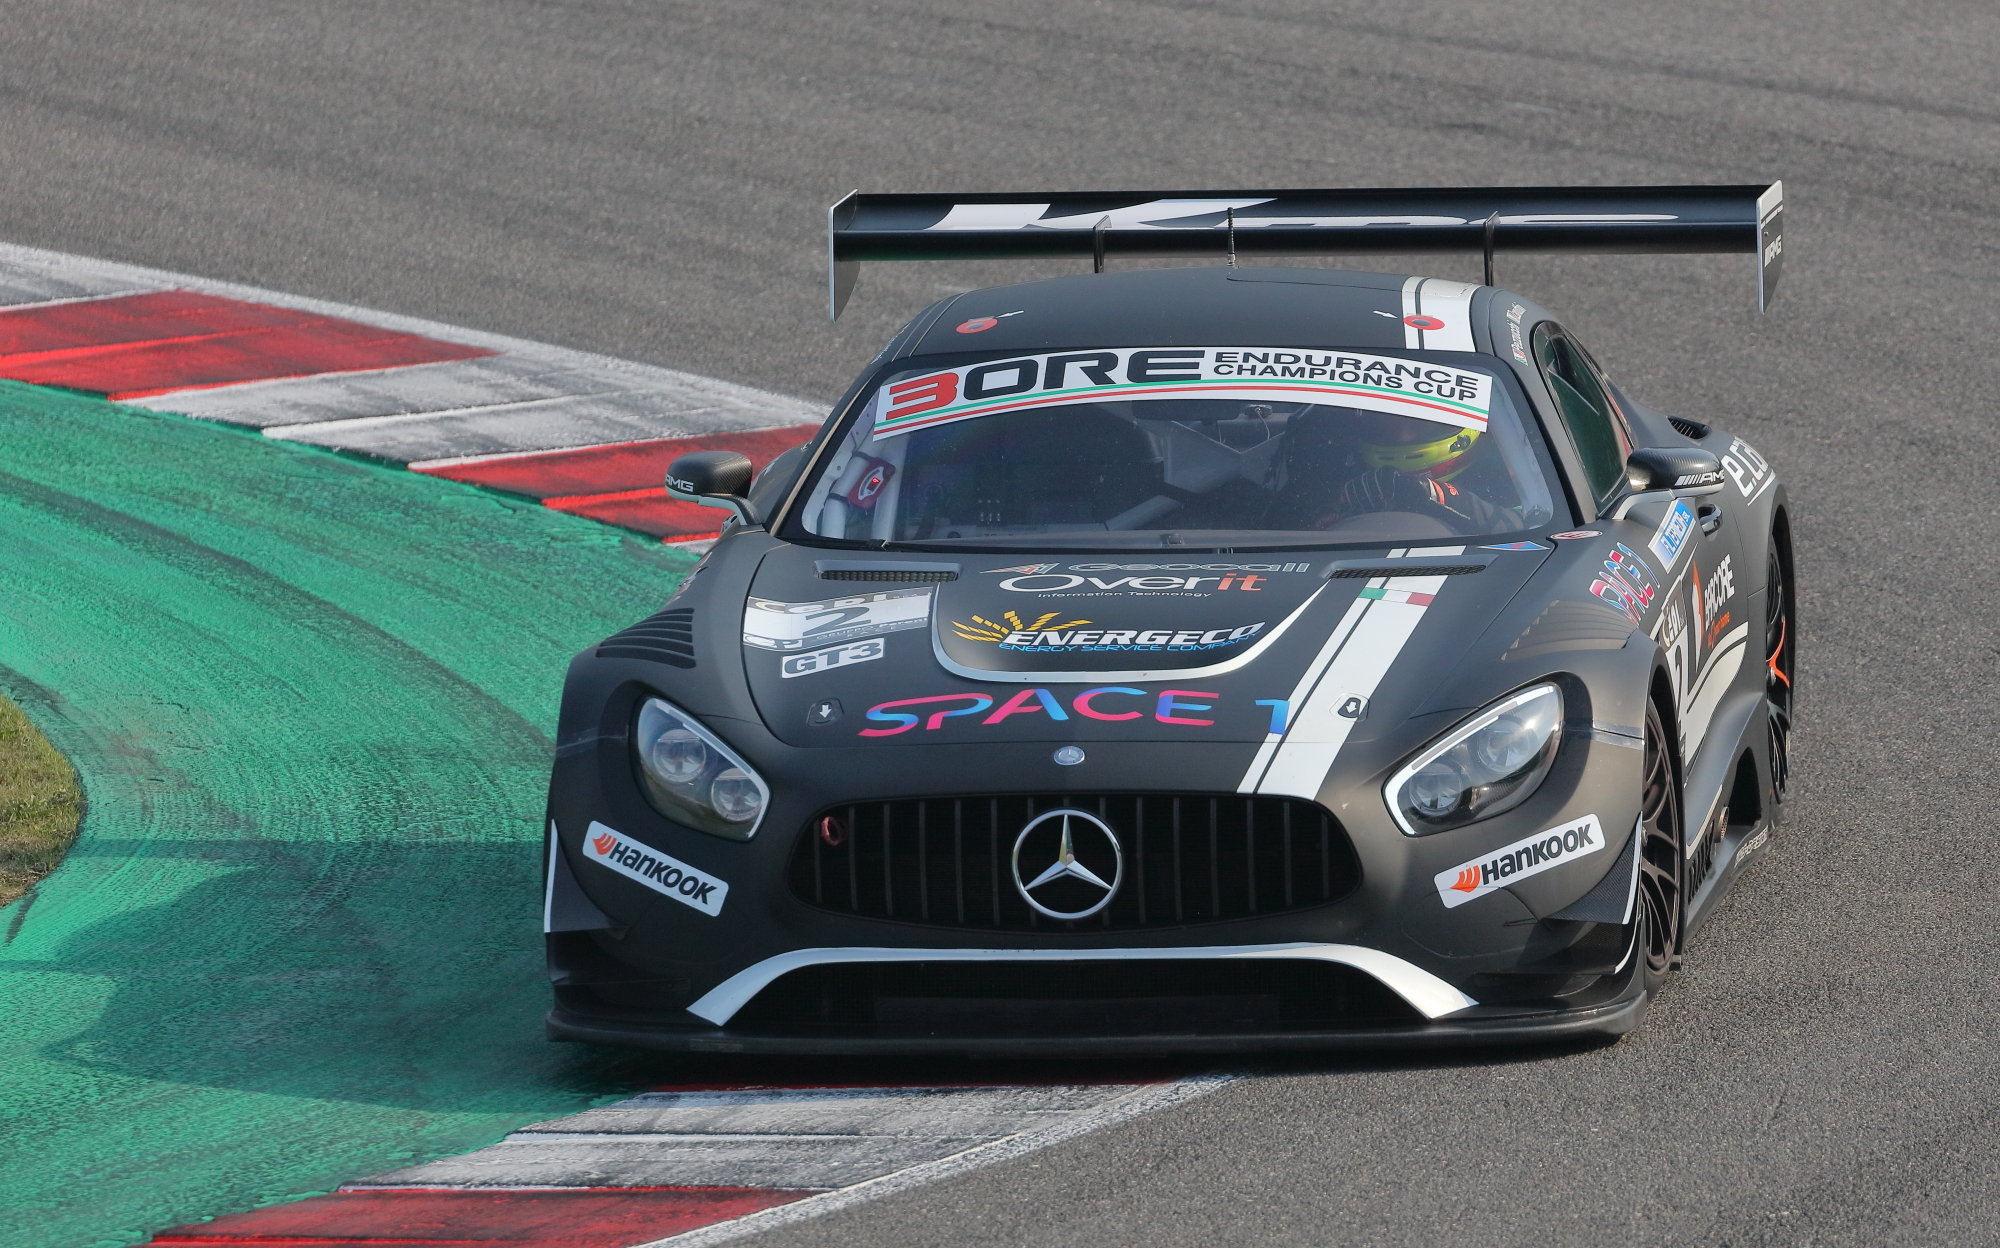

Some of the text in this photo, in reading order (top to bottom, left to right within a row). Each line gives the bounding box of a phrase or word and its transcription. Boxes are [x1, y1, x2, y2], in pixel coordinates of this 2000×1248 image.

[1213, 364, 1477, 401] CHAMPIONS CUP
[1214, 351, 1479, 391] ENDURANCE
[665, 473, 694, 493] AMG
[998, 572, 1268, 593] Overit
[1037, 590, 1212, 598] Information Technology
[803, 606, 872, 638] 2
[1002, 621, 1266, 646] ENERGECO
[998, 630, 1262, 653] ENERGY SERVICE COMPANY
[783, 642, 883, 675] GT3
[857, 686, 1290, 738] SPACE 1
